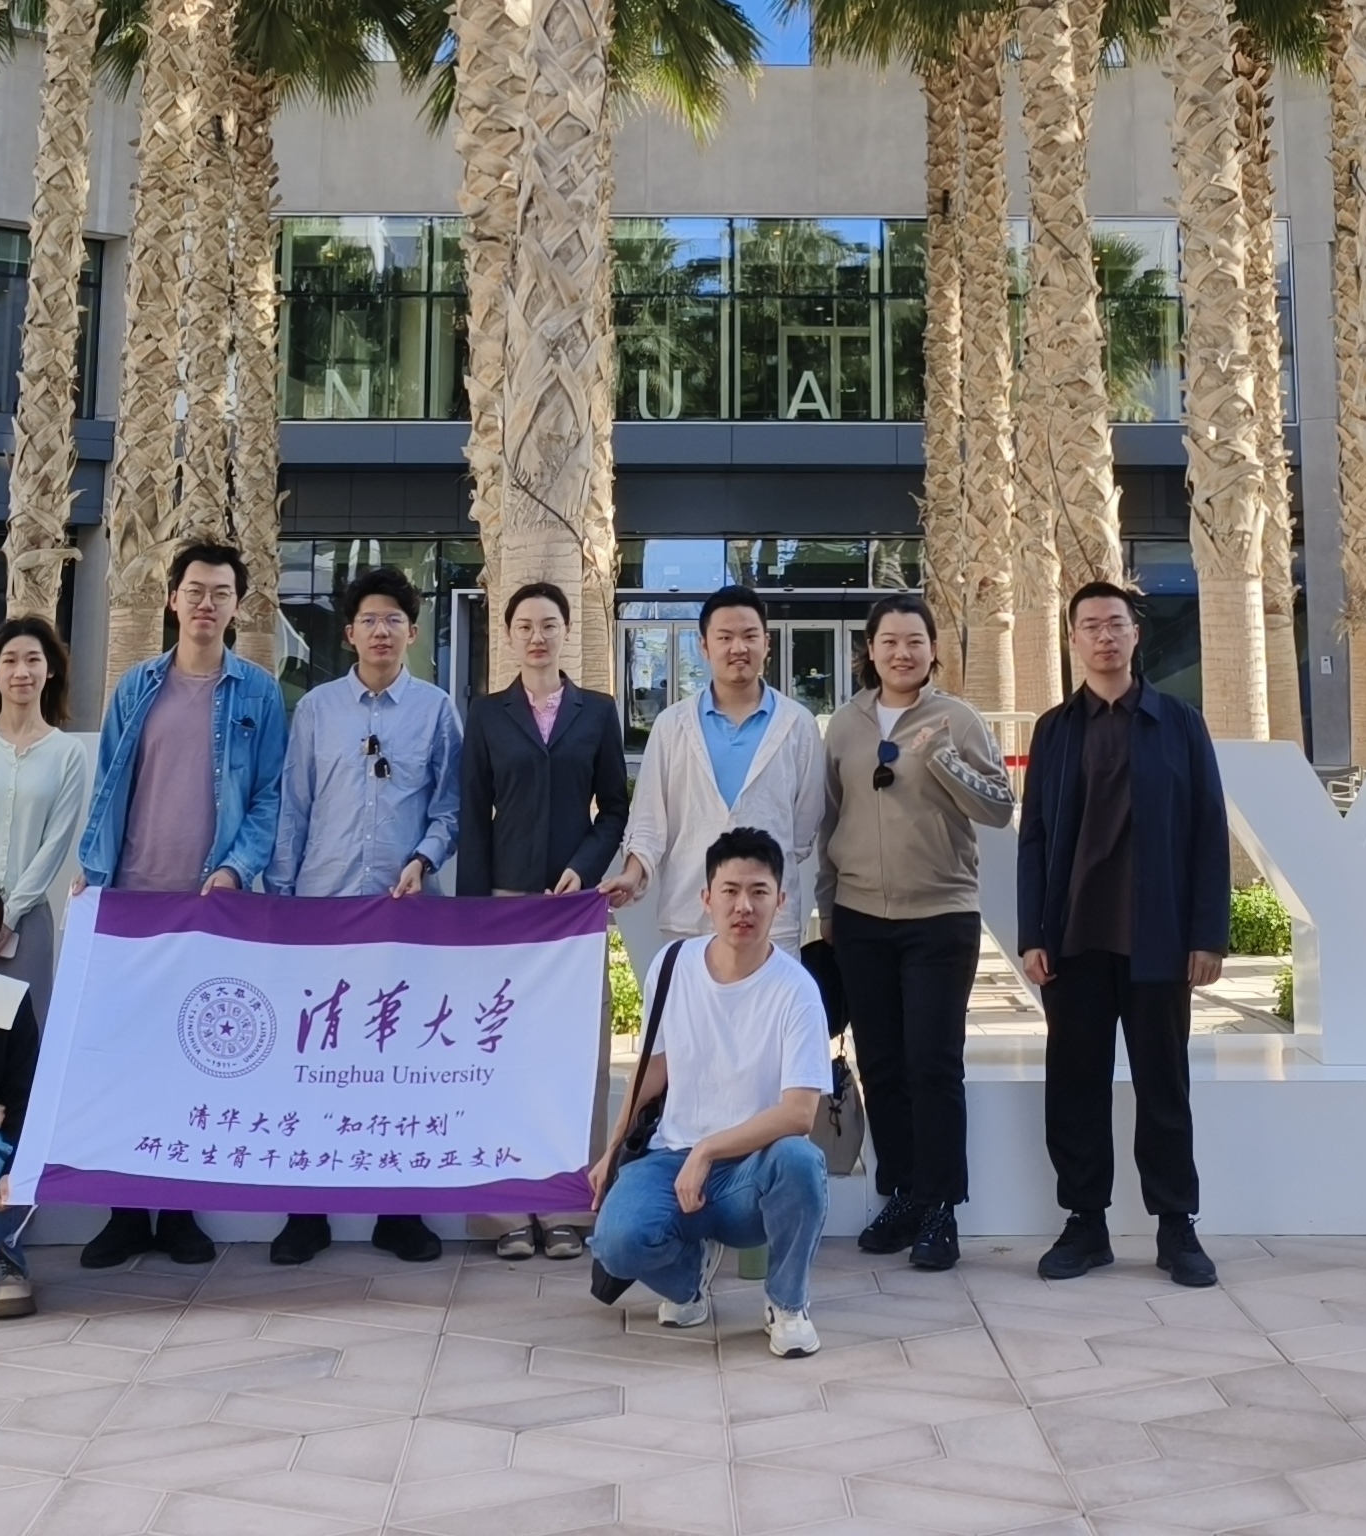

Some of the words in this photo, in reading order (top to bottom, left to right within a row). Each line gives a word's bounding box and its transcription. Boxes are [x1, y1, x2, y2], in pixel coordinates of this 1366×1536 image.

[294, 1064, 385, 1089] Tsinghua
[392, 1063, 495, 1086] University
[134, 1136, 522, 1173] 研究生骨干海外实践西亚支队
